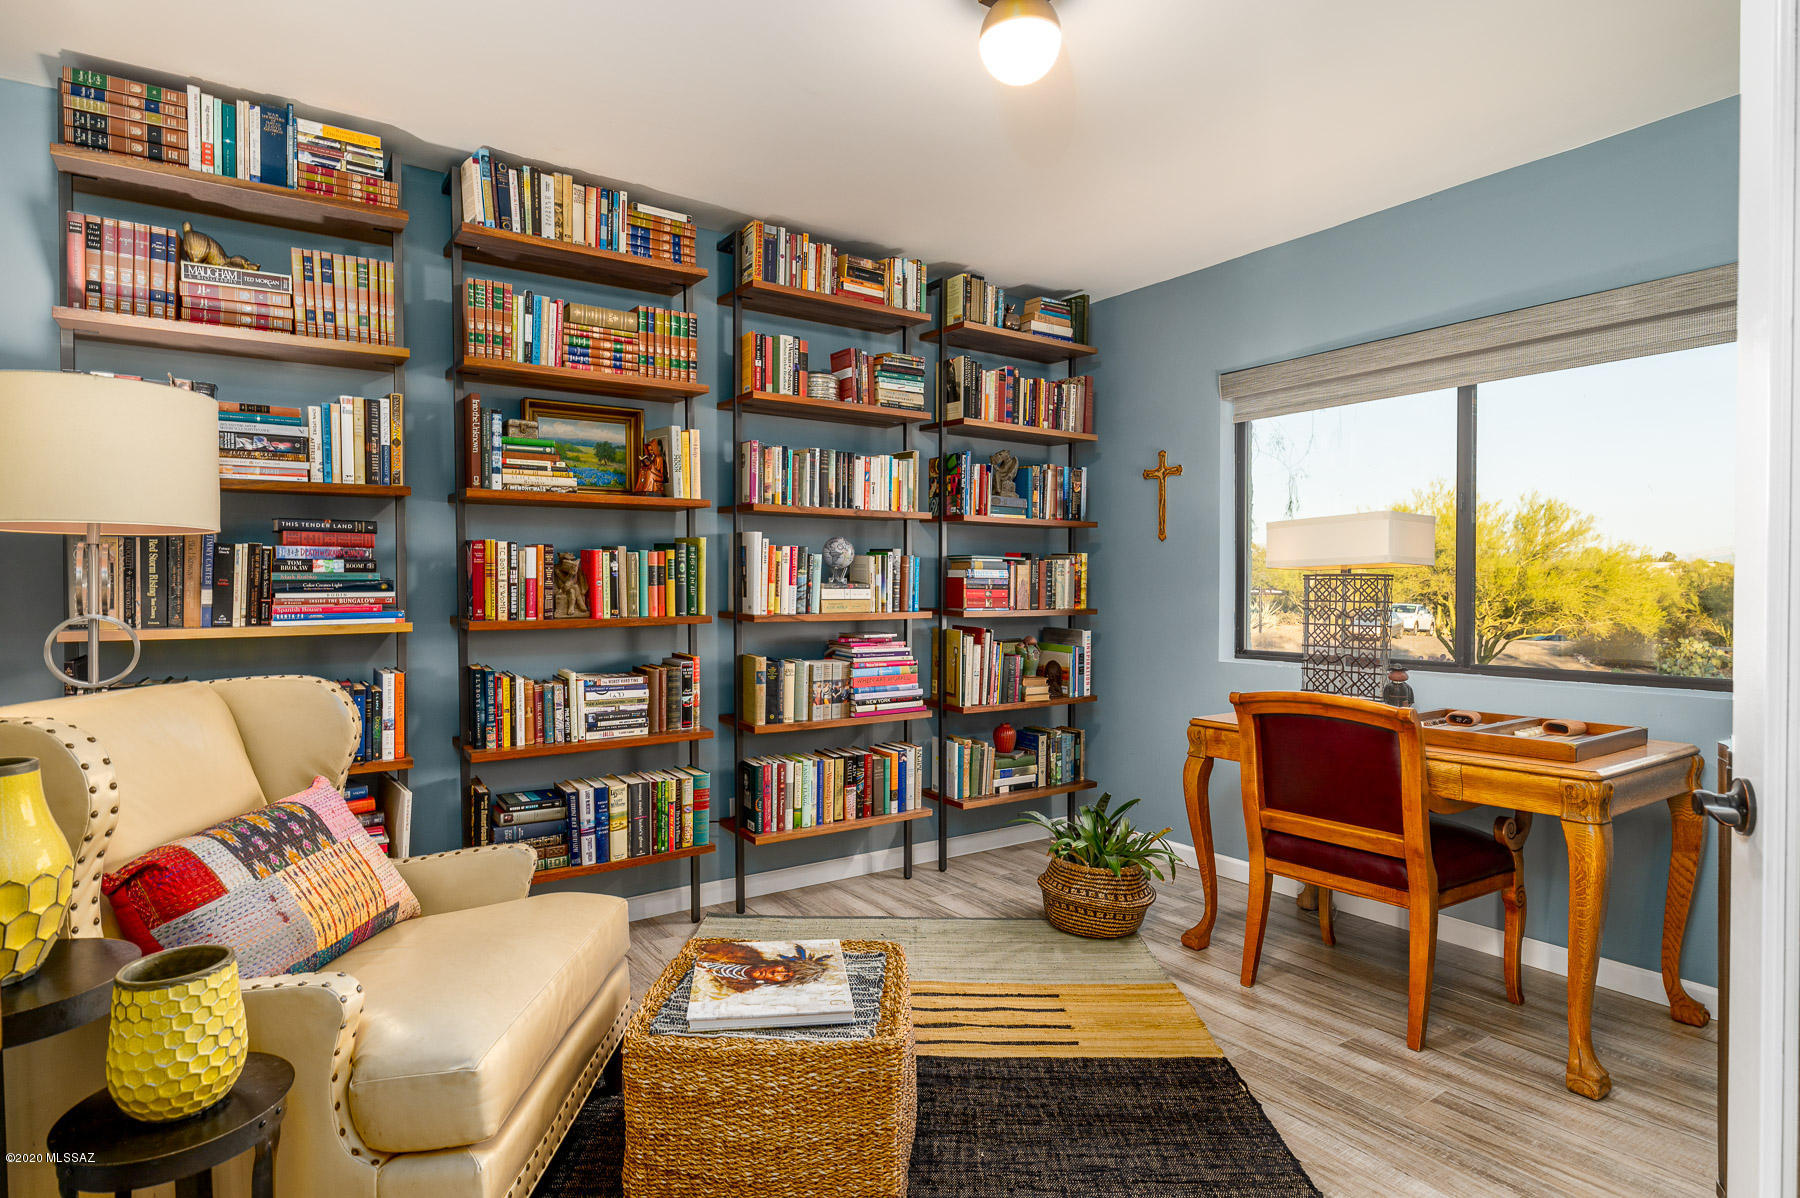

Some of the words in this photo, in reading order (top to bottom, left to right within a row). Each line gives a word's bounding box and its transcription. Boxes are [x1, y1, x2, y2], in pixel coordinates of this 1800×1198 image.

[188, 265, 237, 281] MAUGHAM
[255, 278, 280, 287] MORGAN
[472, 422, 480, 453] Unknown
[149, 539, 158, 552] Red
[300, 548, 319, 557] DEATH
[149, 553, 158, 574] Storm
[147, 574, 158, 597] Rising
